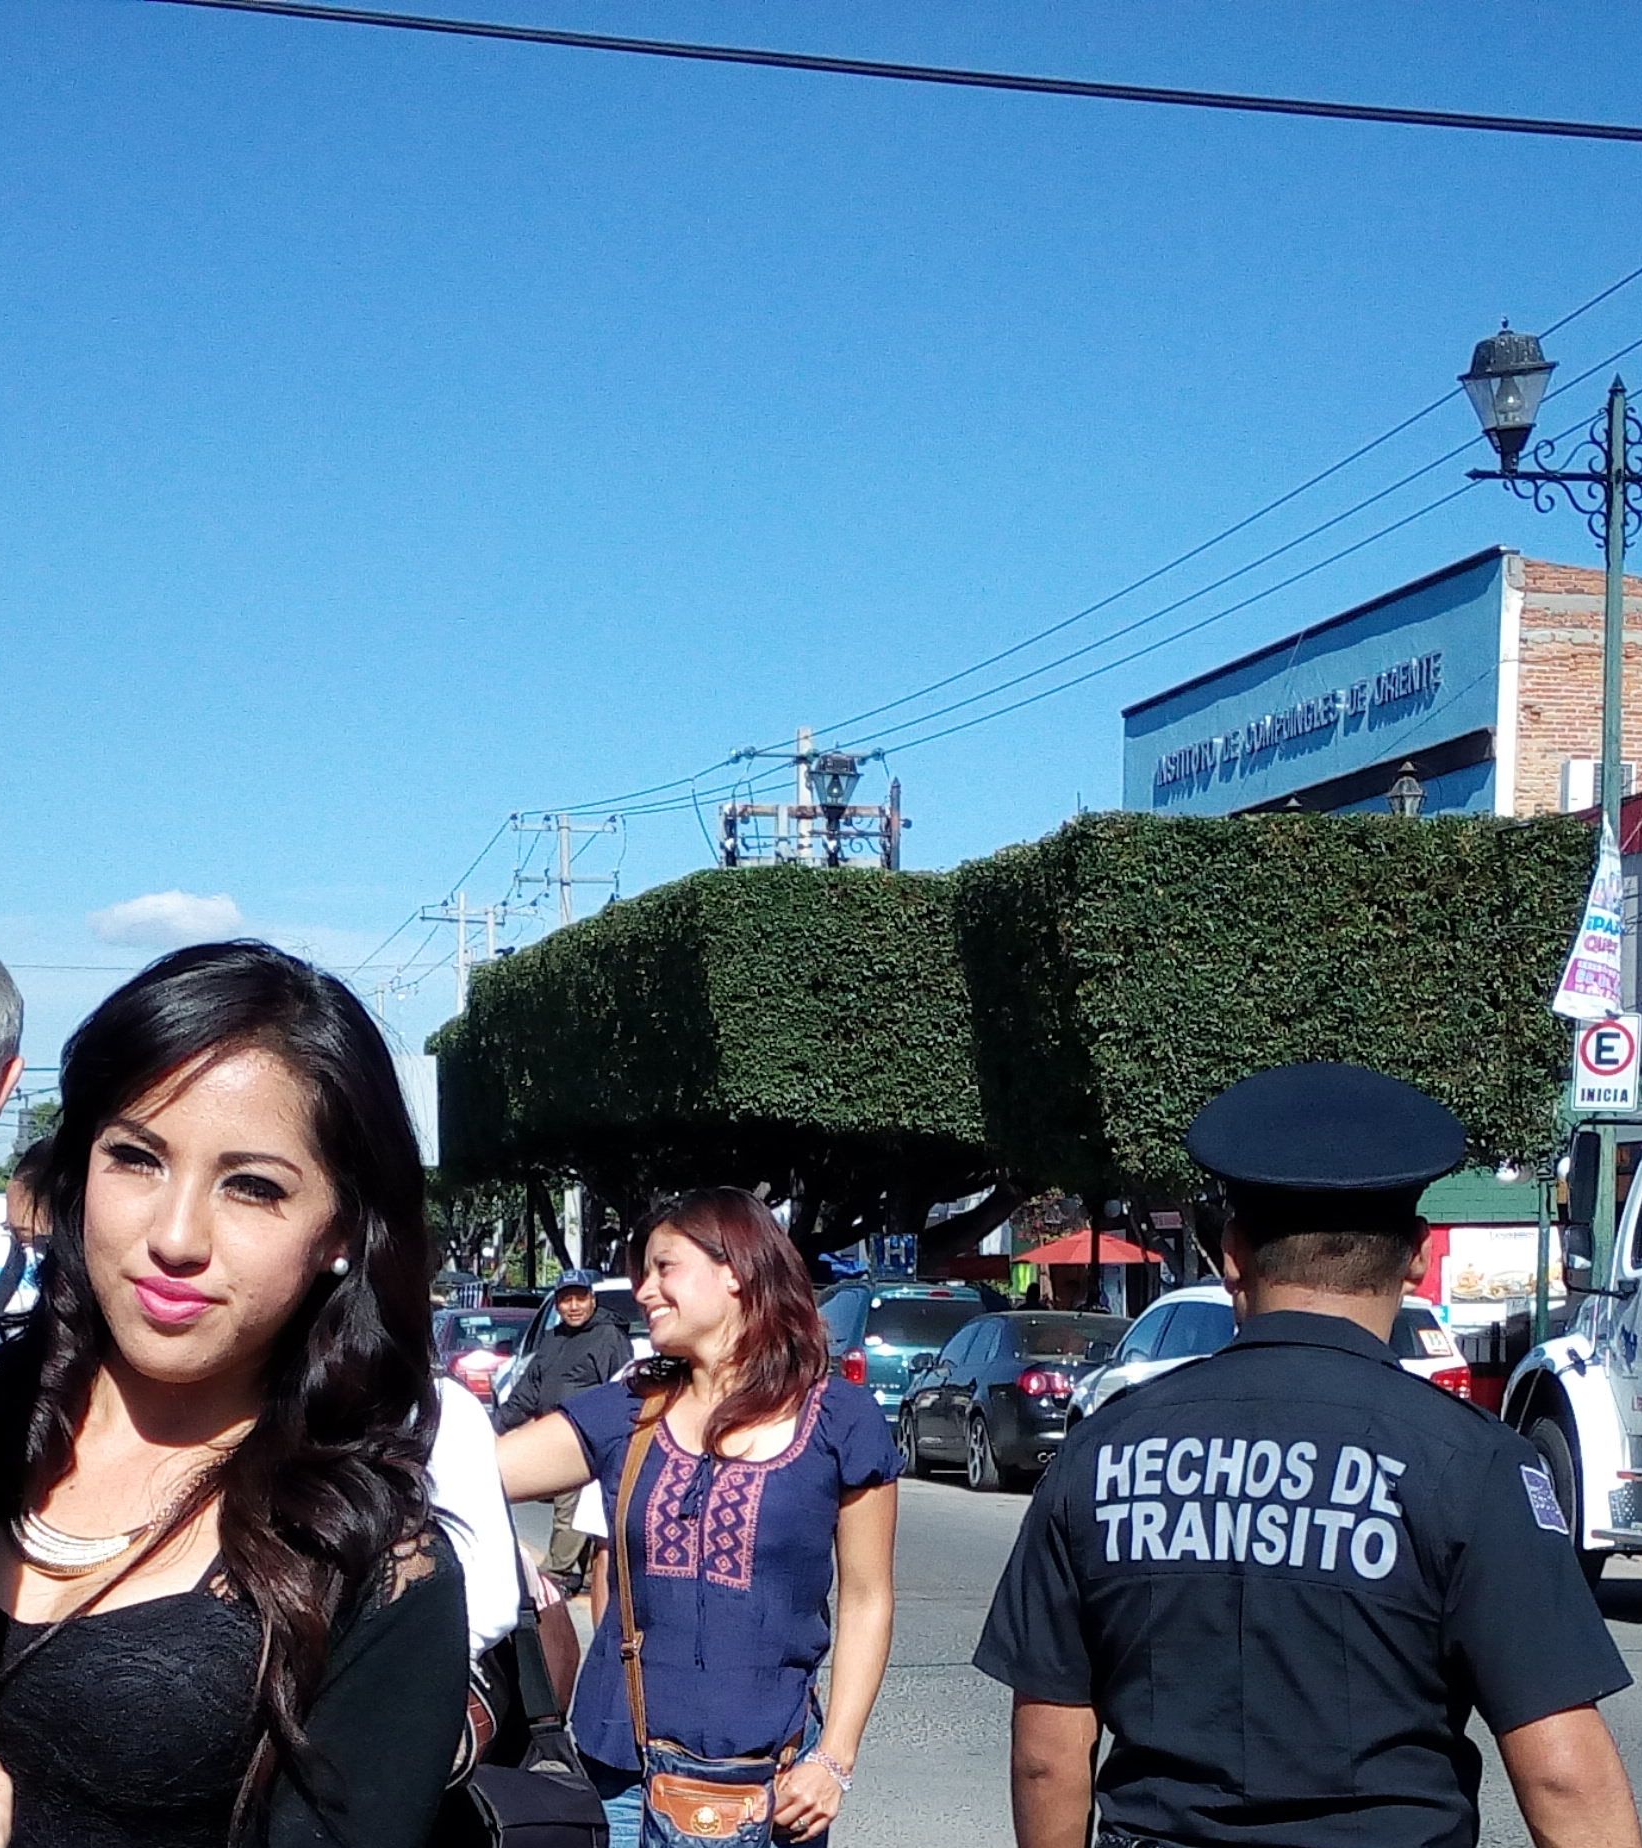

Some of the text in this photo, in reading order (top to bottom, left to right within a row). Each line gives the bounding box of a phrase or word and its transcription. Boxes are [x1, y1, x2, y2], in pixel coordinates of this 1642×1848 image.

[1594, 1032, 1621, 1065] E
[1579, 1087, 1629, 1103] INICIA
[1095, 1436, 1408, 1518] HECHOS DE
[1094, 1501, 1398, 1581] TRANSITO
